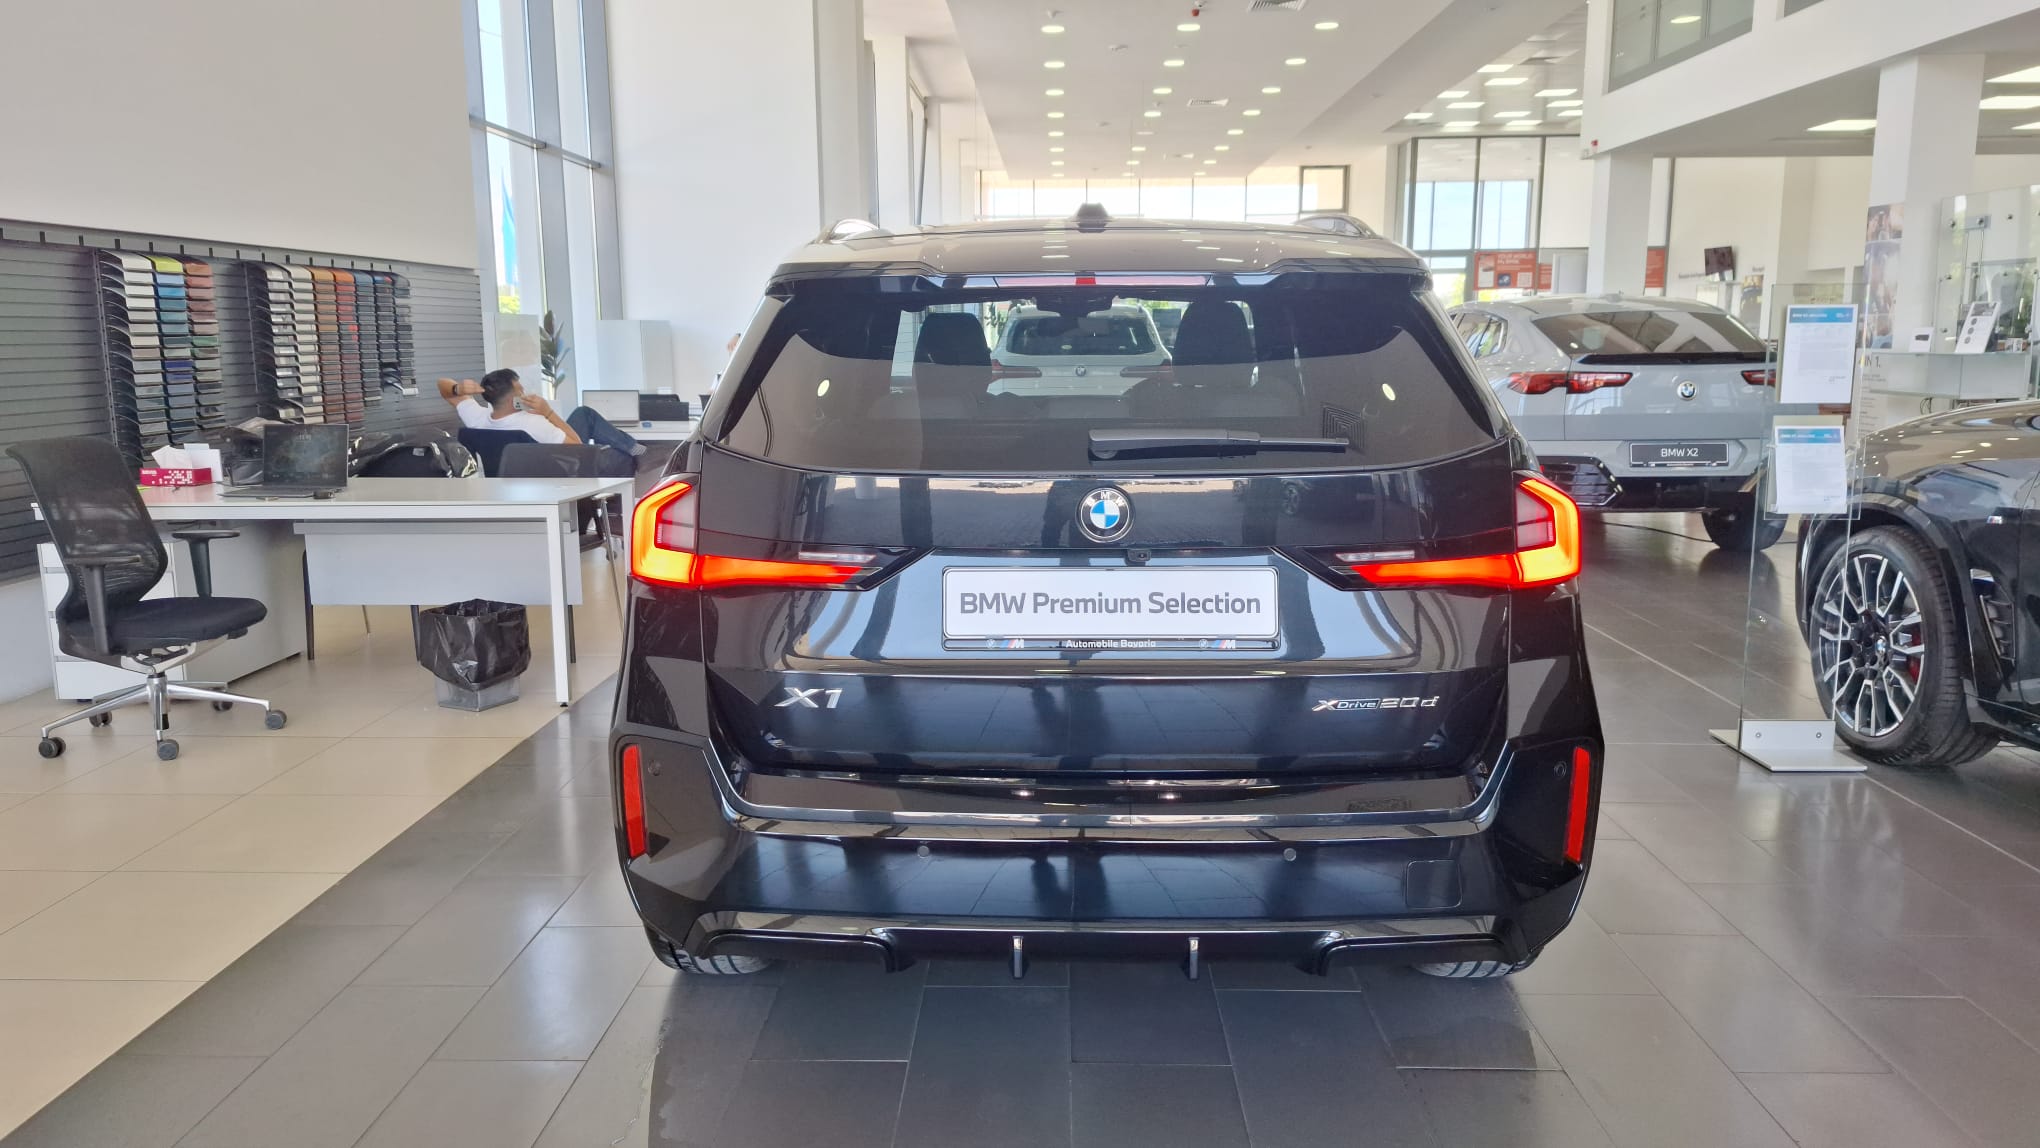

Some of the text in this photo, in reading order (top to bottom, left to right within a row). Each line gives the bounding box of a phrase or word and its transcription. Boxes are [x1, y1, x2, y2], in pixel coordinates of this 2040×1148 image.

[1661, 448, 1699, 457] BMW X2
[960, 592, 1261, 614] BMW Premium Selection
[1065, 639, 1156, 649] Automobile Bavaria
[774, 687, 843, 709] X1
